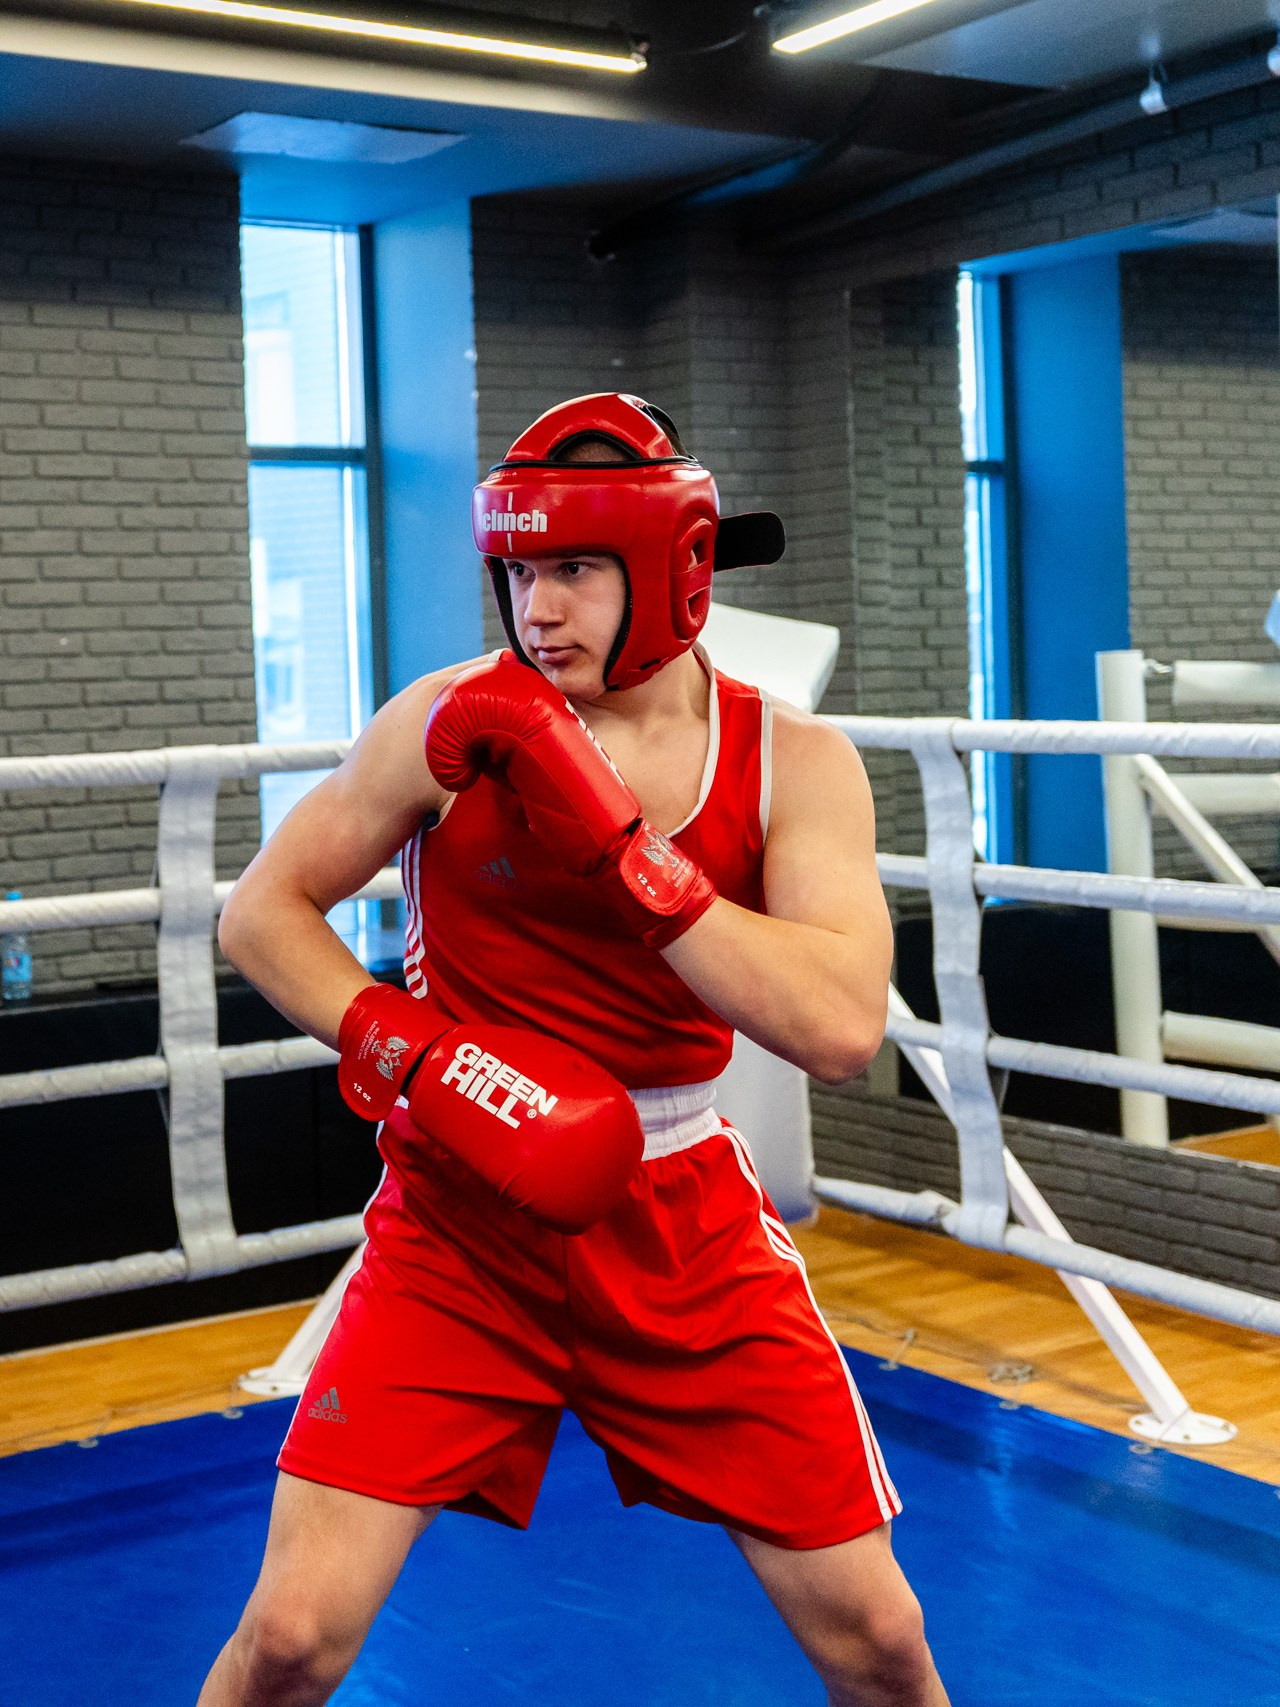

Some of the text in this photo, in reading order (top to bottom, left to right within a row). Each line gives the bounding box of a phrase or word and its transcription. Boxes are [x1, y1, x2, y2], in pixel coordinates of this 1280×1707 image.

[482, 509, 548, 533] clinch
[637, 873, 657, 897] 12 oz
[454, 1042, 559, 1117] GREEN
[353, 1082, 372, 1103] 12 oz
[307, 1406, 348, 1425] adidas
